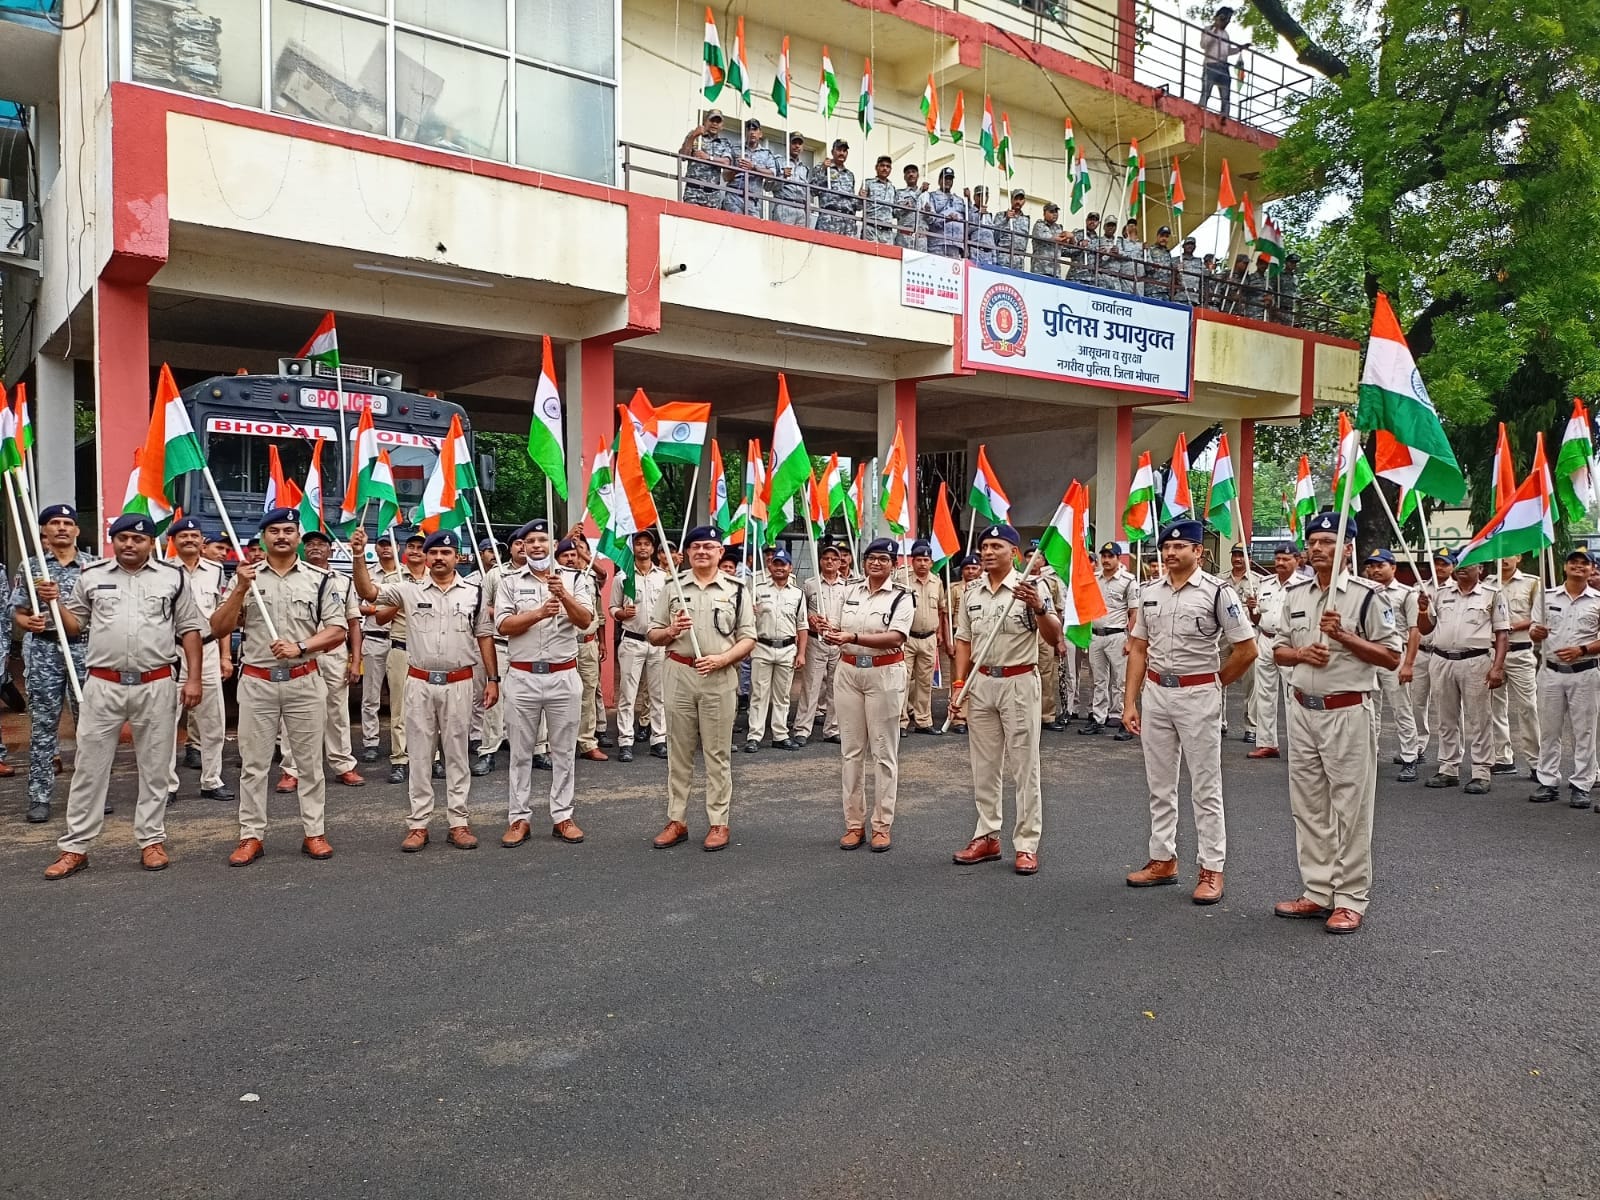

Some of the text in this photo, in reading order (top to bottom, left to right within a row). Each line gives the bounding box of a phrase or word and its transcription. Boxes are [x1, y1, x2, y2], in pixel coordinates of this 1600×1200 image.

[1091, 300, 1133, 318] कार्यालय
[1042, 303, 1176, 353] पुलिस उपायुक्त
[1078, 345, 1143, 365] आसूचना व सुरक्षा
[1057, 358, 1084, 374] नगरीय
[1113, 364, 1134, 380] जिला
[1135, 368, 1160, 384] भोपाल
[214, 420, 328, 440] BHOPAL
